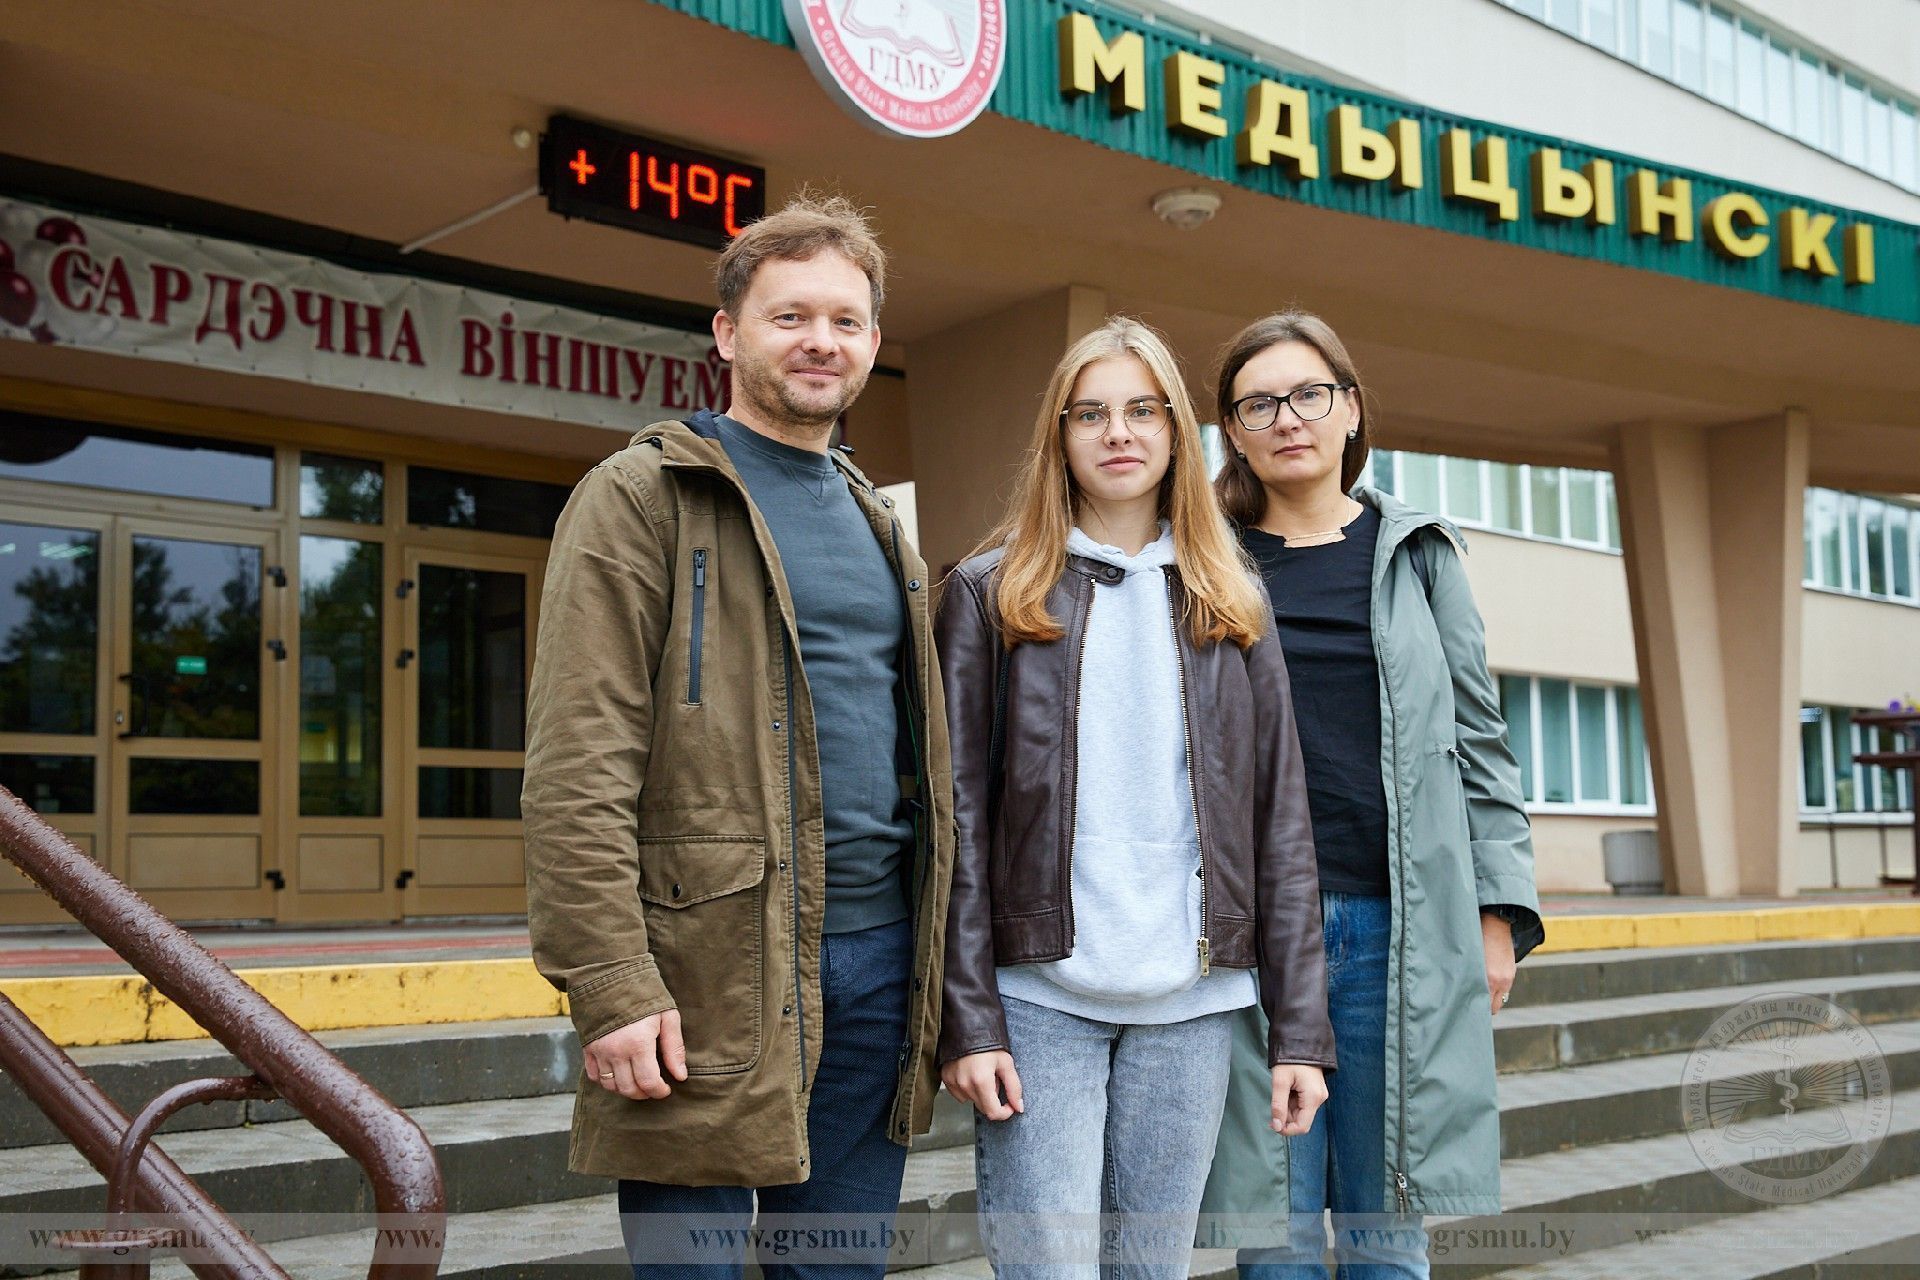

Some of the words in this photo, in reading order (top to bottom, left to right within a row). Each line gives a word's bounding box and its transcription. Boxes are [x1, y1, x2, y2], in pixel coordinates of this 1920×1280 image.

[867, 46, 946, 92] ГДМУ
[1060, 11, 1876, 286] МЕДЫЦЫНСКІ
[50, 247, 426, 367] САРДЭЧНА
